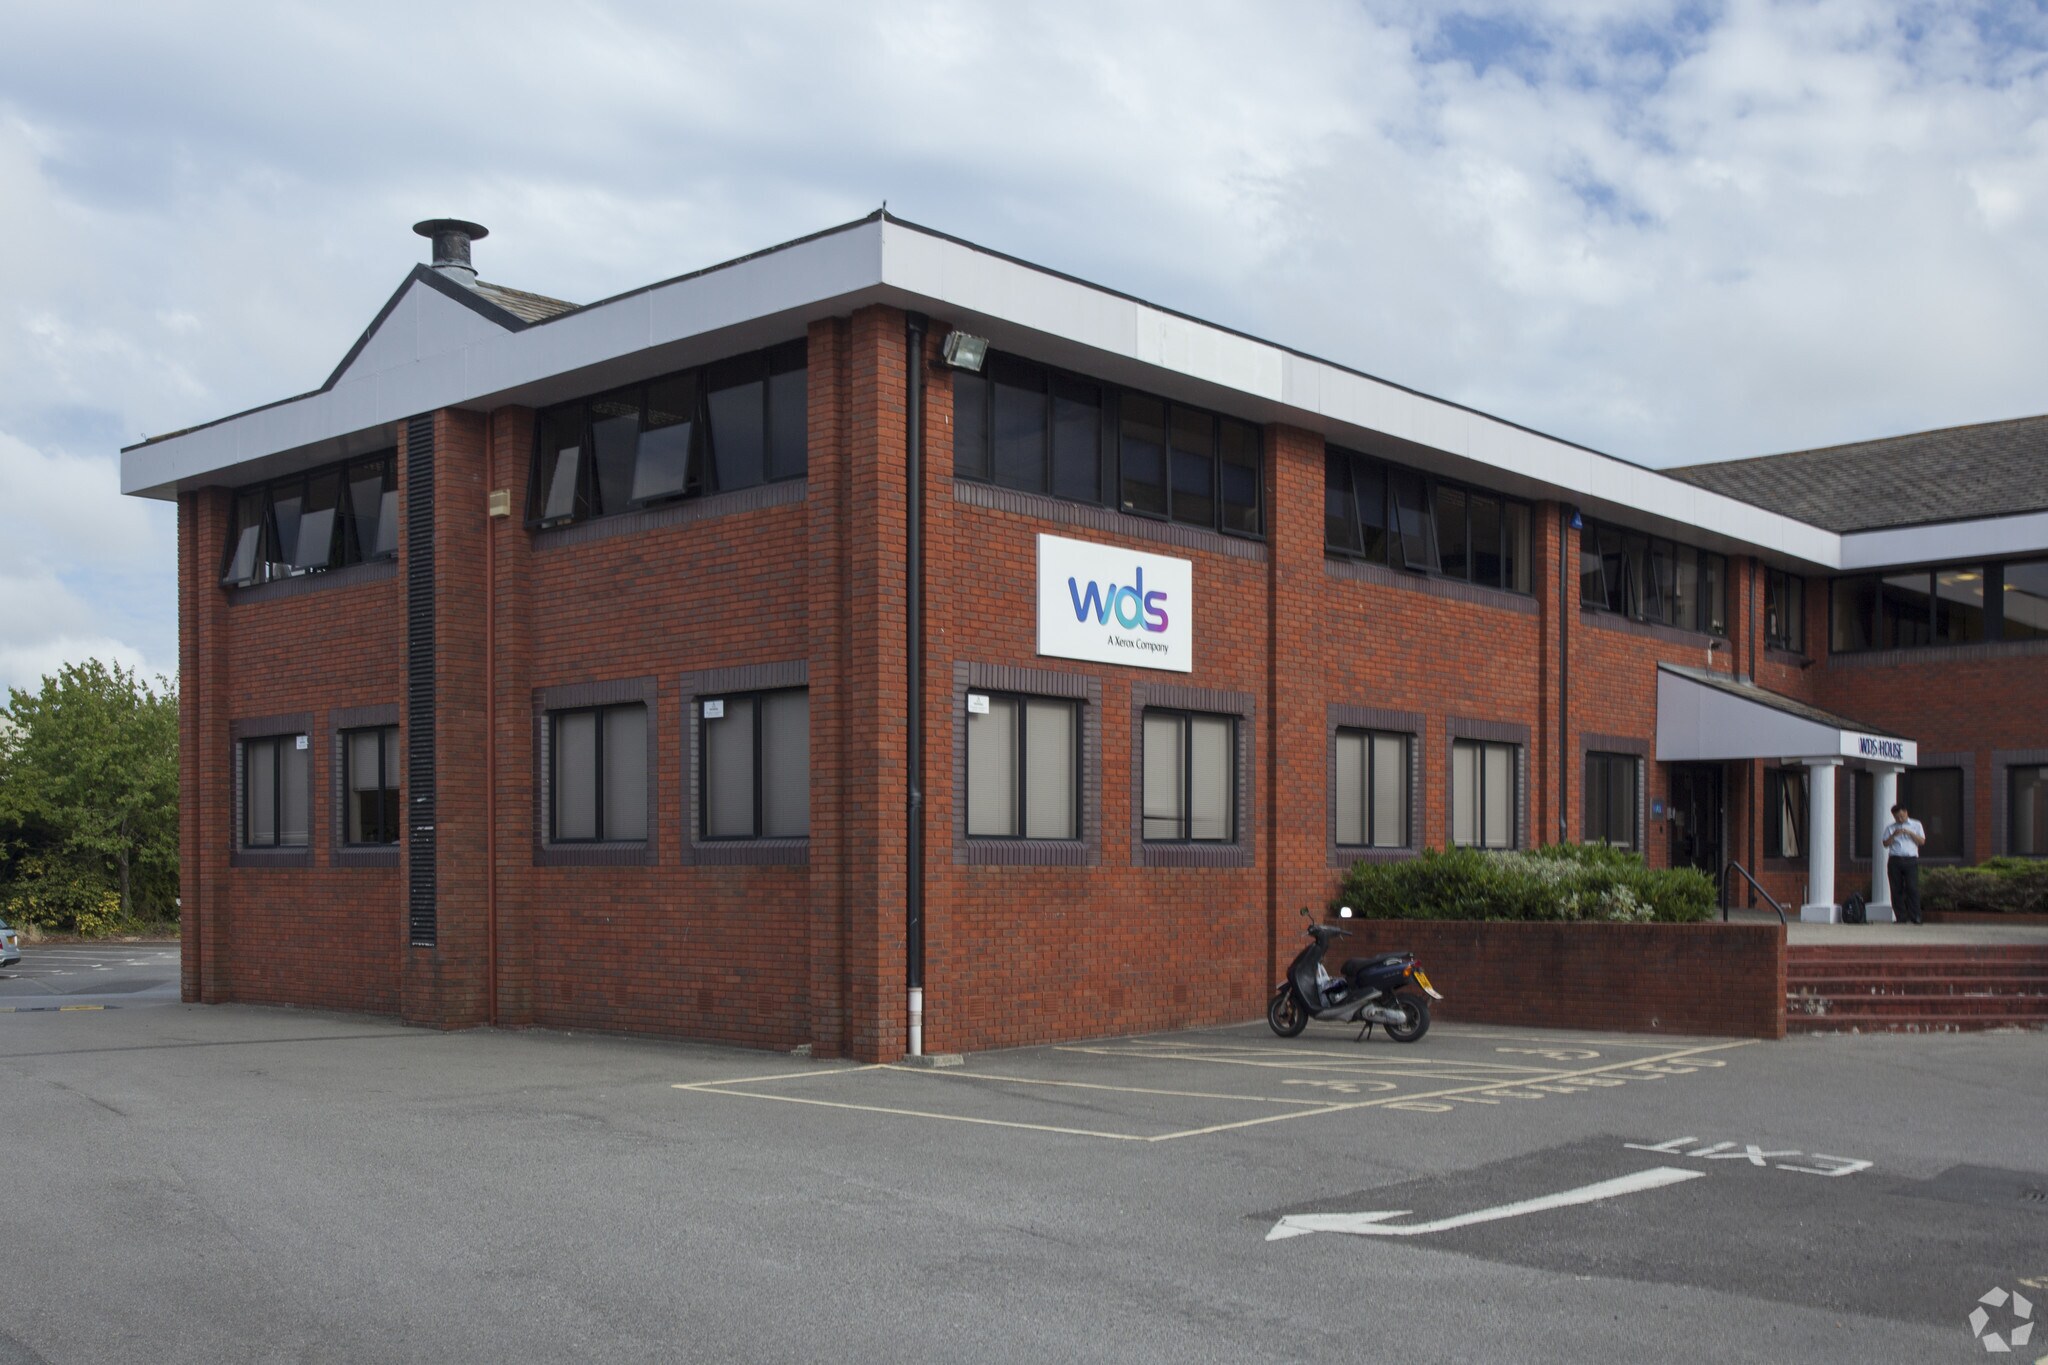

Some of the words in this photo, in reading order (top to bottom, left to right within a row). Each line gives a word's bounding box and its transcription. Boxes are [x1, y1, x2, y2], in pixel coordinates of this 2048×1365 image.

[1068, 566, 1168, 633] wds
[1108, 635, 1113, 645] A
[1115, 635, 1134, 648] Xerox
[1136, 638, 1168, 655] Company
[1858, 736, 1877, 756] WDS
[1879, 740, 1903, 760] HOUSE
[1381, 1058, 1727, 1112] DISABLED
